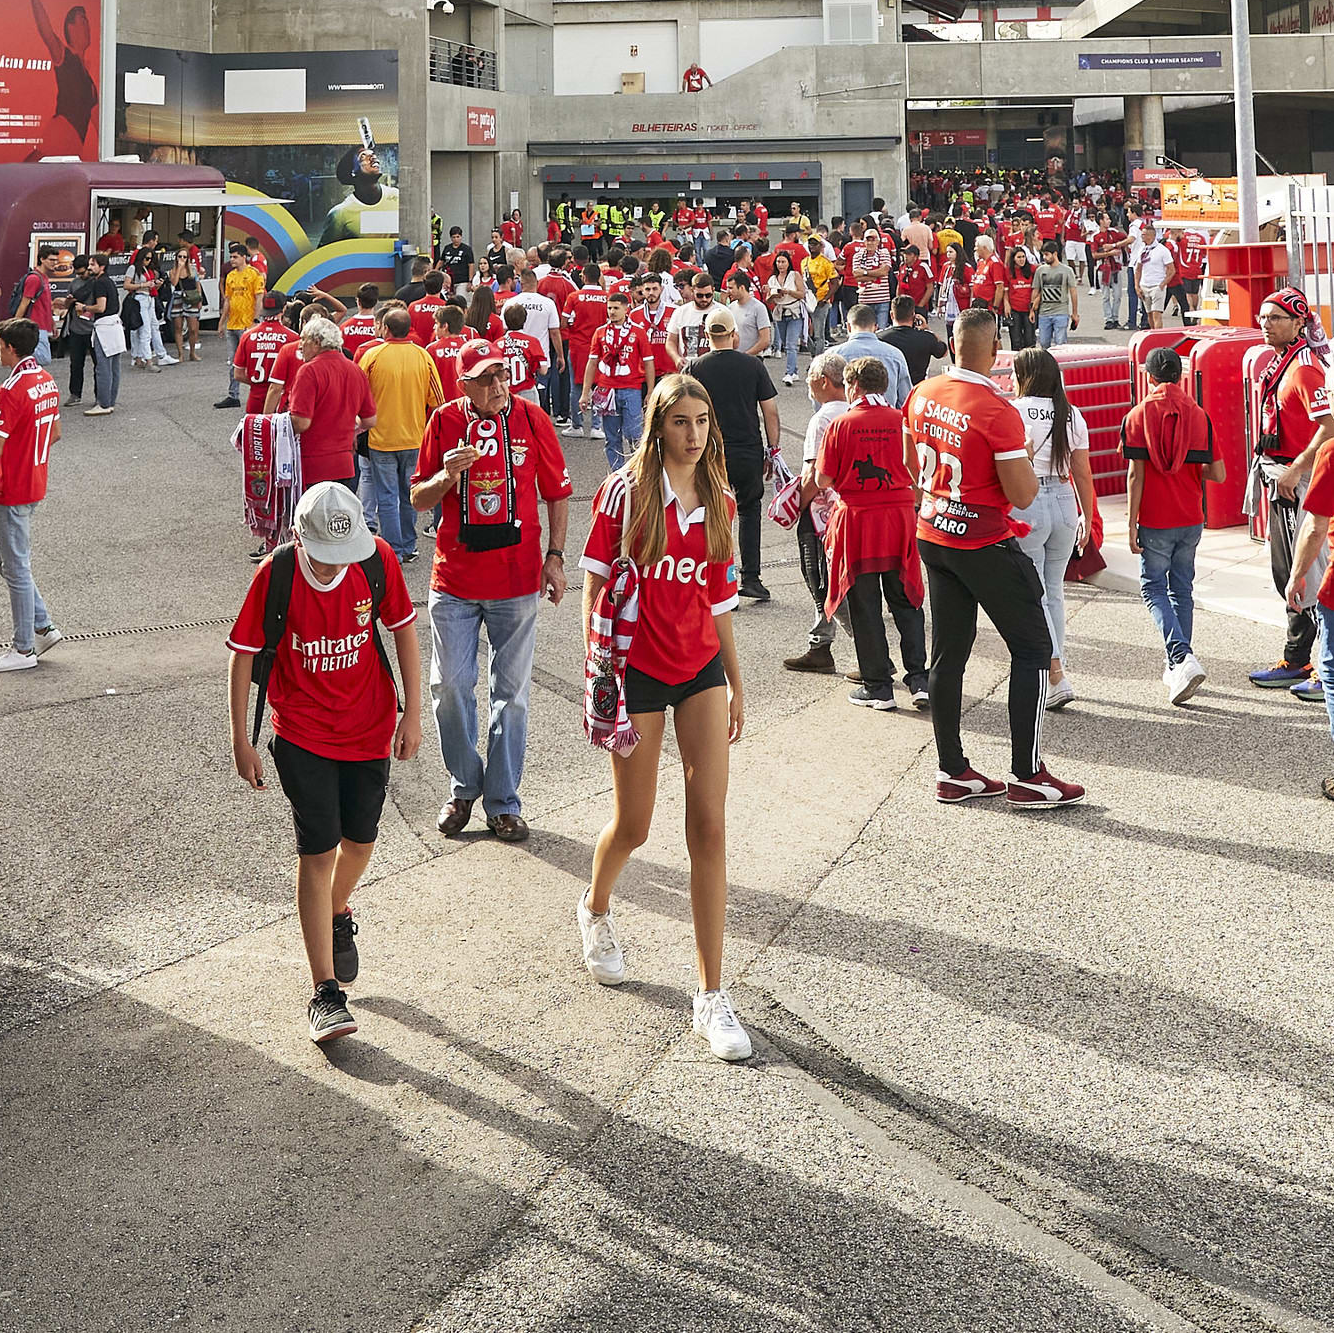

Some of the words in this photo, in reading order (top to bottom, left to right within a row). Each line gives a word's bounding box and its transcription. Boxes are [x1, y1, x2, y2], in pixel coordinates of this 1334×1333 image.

[490, 115, 495, 138] 8
[631, 123, 697, 133] BILHETEIRAS
[943, 136, 954, 144] 13
[585, 294, 607, 303] SAGRES
[257, 332, 287, 343] SAGRES
[256, 342, 276, 350] BRUNO
[923, 400, 971, 432] SAGRES
[35, 414, 54, 466] 17
[950, 501, 967, 511] CASA
[332, 521, 350, 530] NYC
[933, 516, 967, 535] FARO
[292, 629, 369, 657] Emirates
[303, 657, 318, 673] FLY
[321, 650, 359, 672] BETTER
